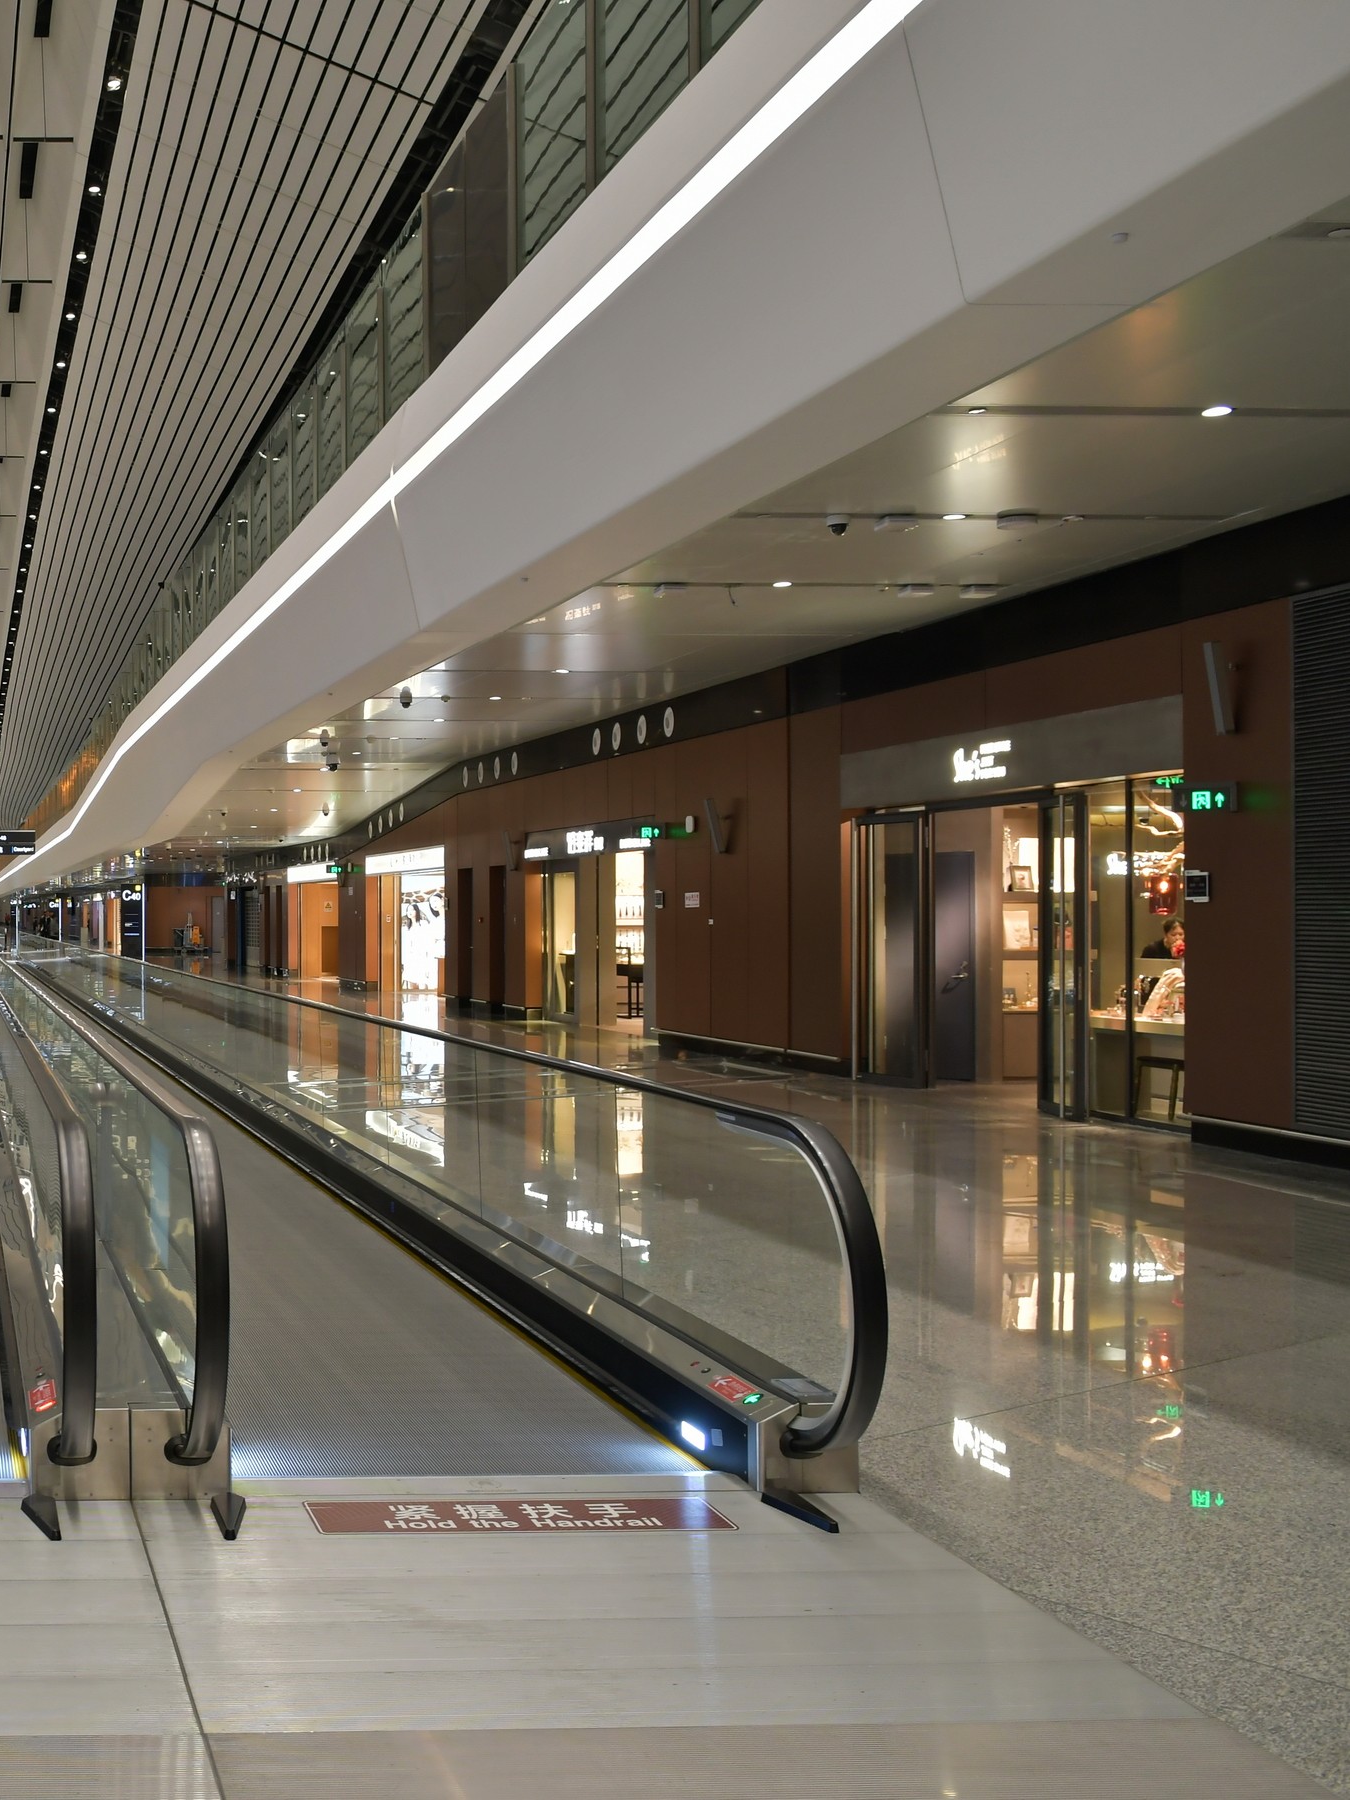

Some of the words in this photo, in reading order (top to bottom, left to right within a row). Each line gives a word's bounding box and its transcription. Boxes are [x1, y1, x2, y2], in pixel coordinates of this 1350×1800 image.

[122, 889, 142, 902] C40
[388, 1503, 637, 1521] 紧握扶手
[384, 1519, 457, 1530] Hold
[467, 1518, 520, 1530] the
[532, 1517, 663, 1529] Handrail
